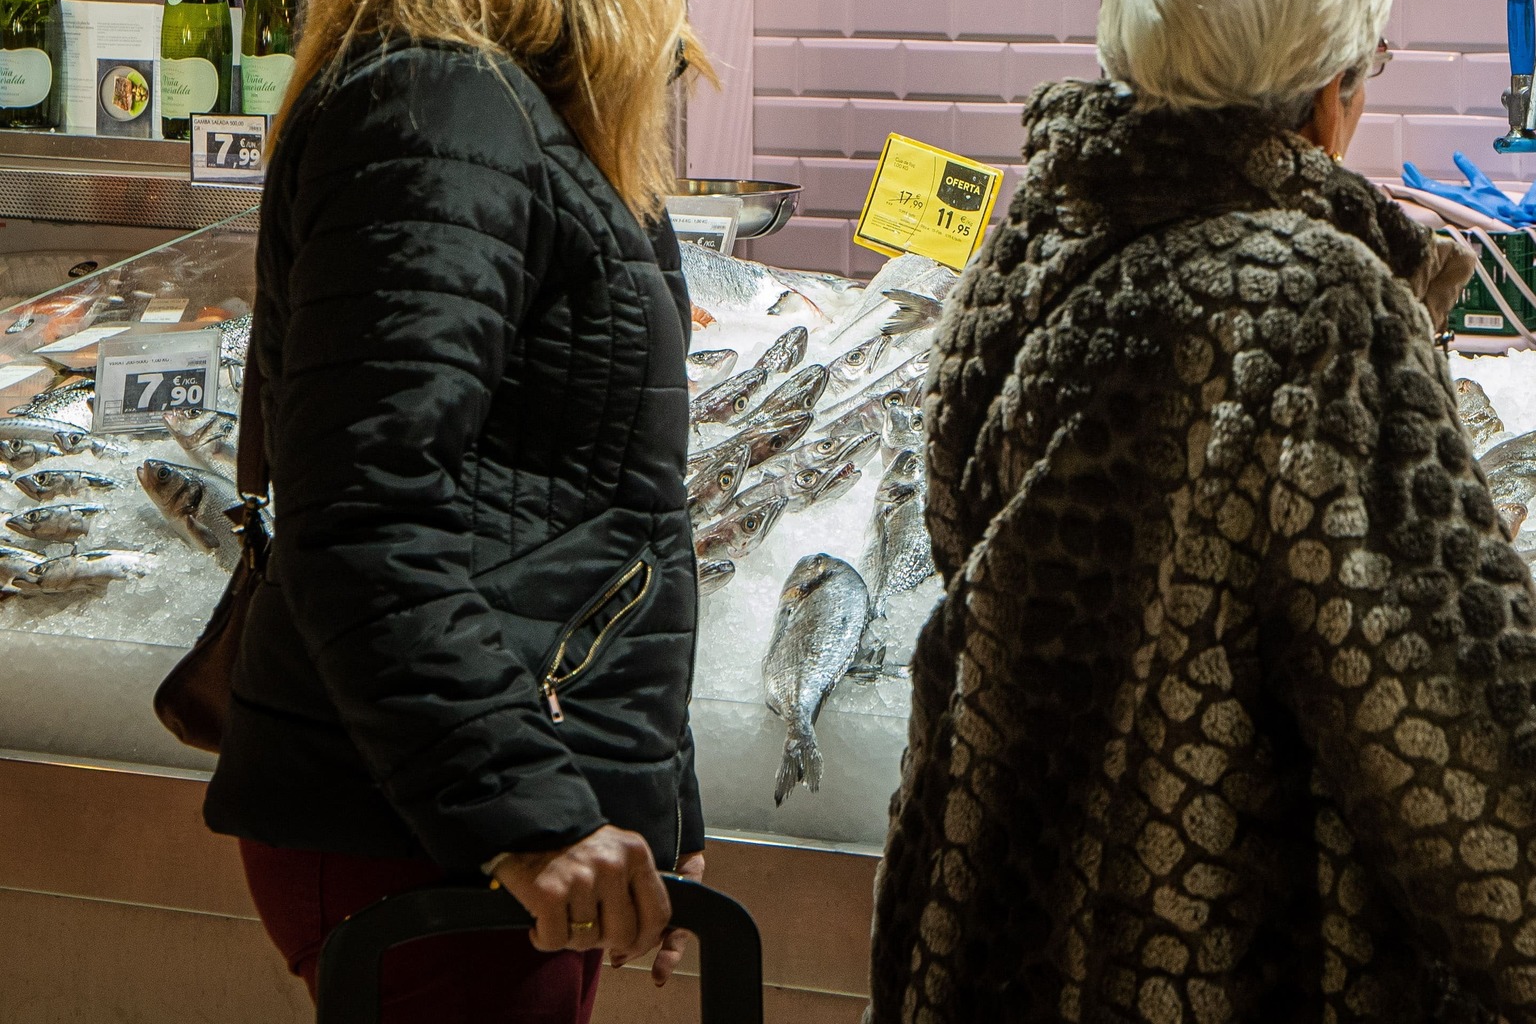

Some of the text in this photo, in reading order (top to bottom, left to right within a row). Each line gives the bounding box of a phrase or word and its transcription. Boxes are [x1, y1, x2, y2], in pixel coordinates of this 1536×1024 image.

[945, 176, 982, 196] OFERTA
[936, 207, 971, 236] 11,95
[137, 372, 204, 411] 7,90
